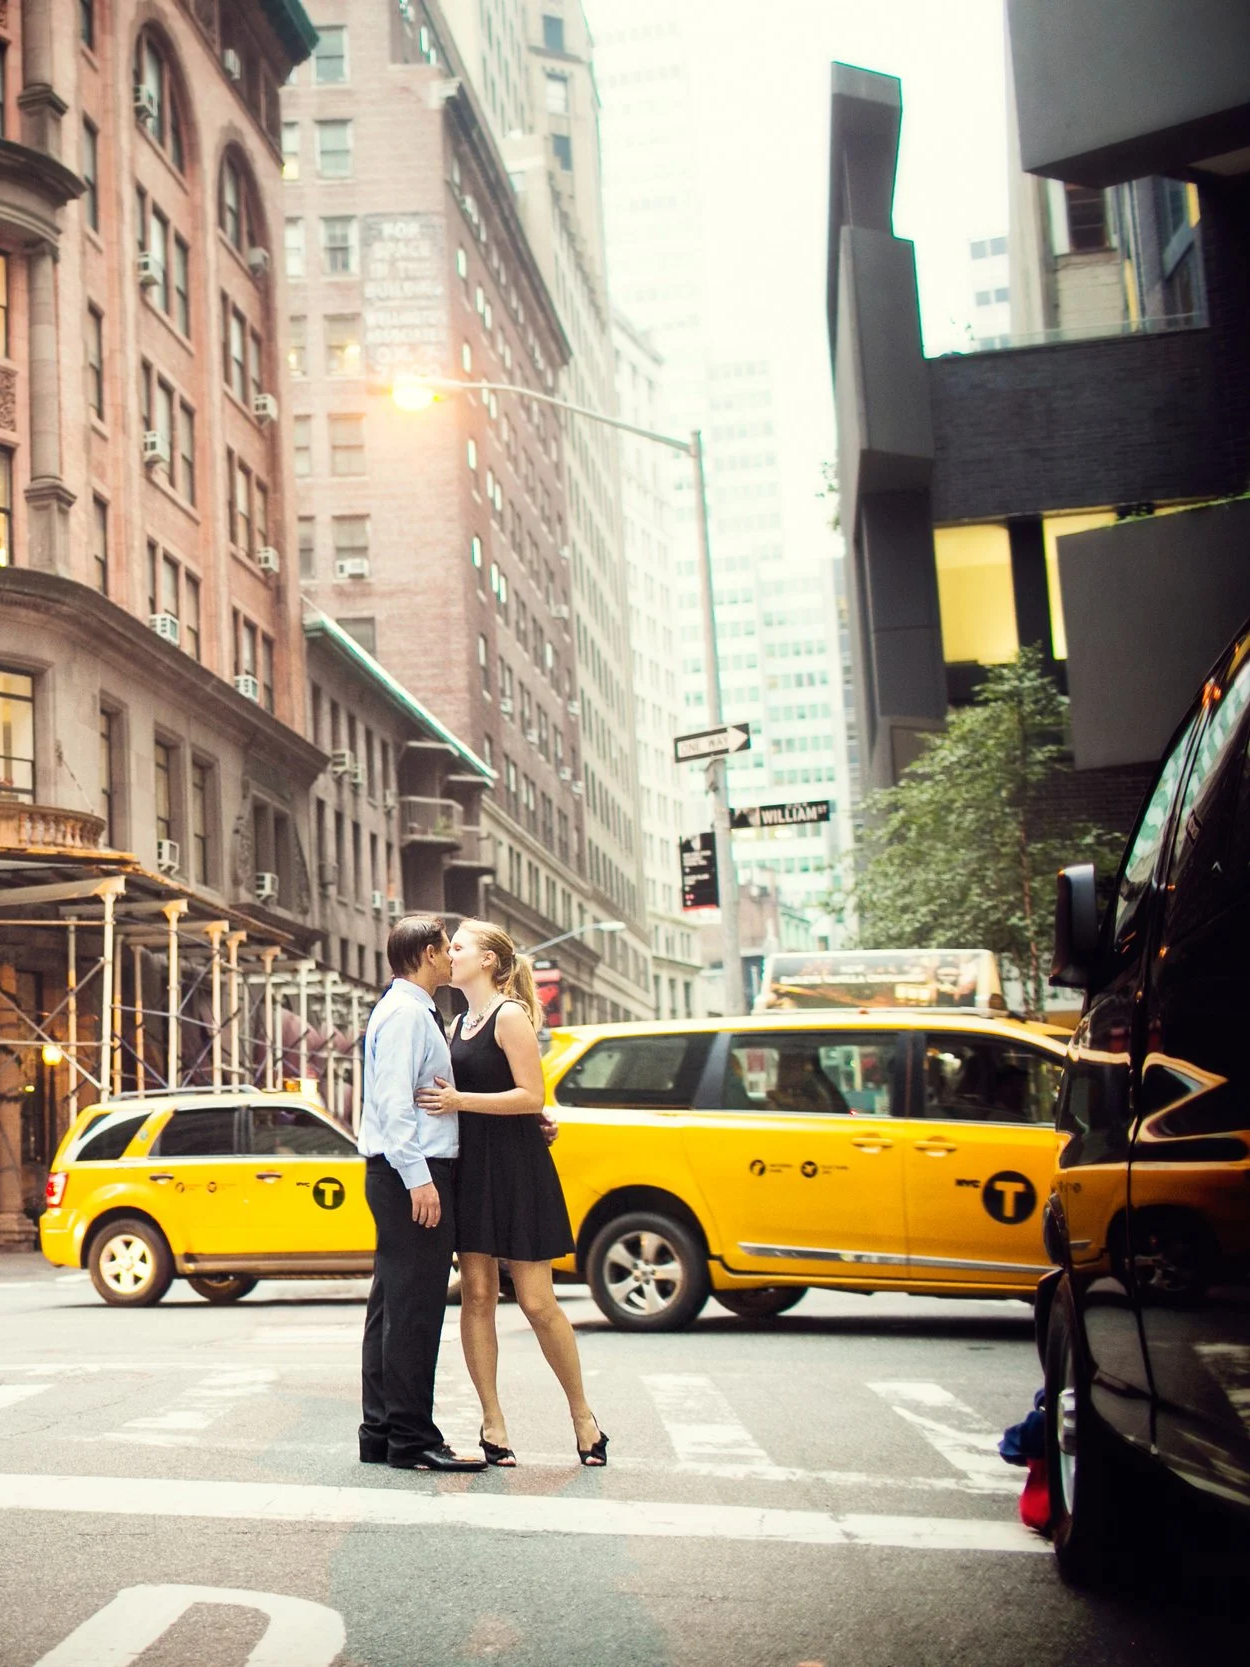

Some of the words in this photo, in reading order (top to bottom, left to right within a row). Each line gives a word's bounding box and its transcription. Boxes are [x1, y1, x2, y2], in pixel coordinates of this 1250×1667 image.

[707, 736, 729, 748] WAY
[761, 805, 818, 824] WILLIAM
[317, 1181, 342, 1207] T
[955, 1178, 981, 1188] NYC
[990, 1176, 1029, 1221] T
